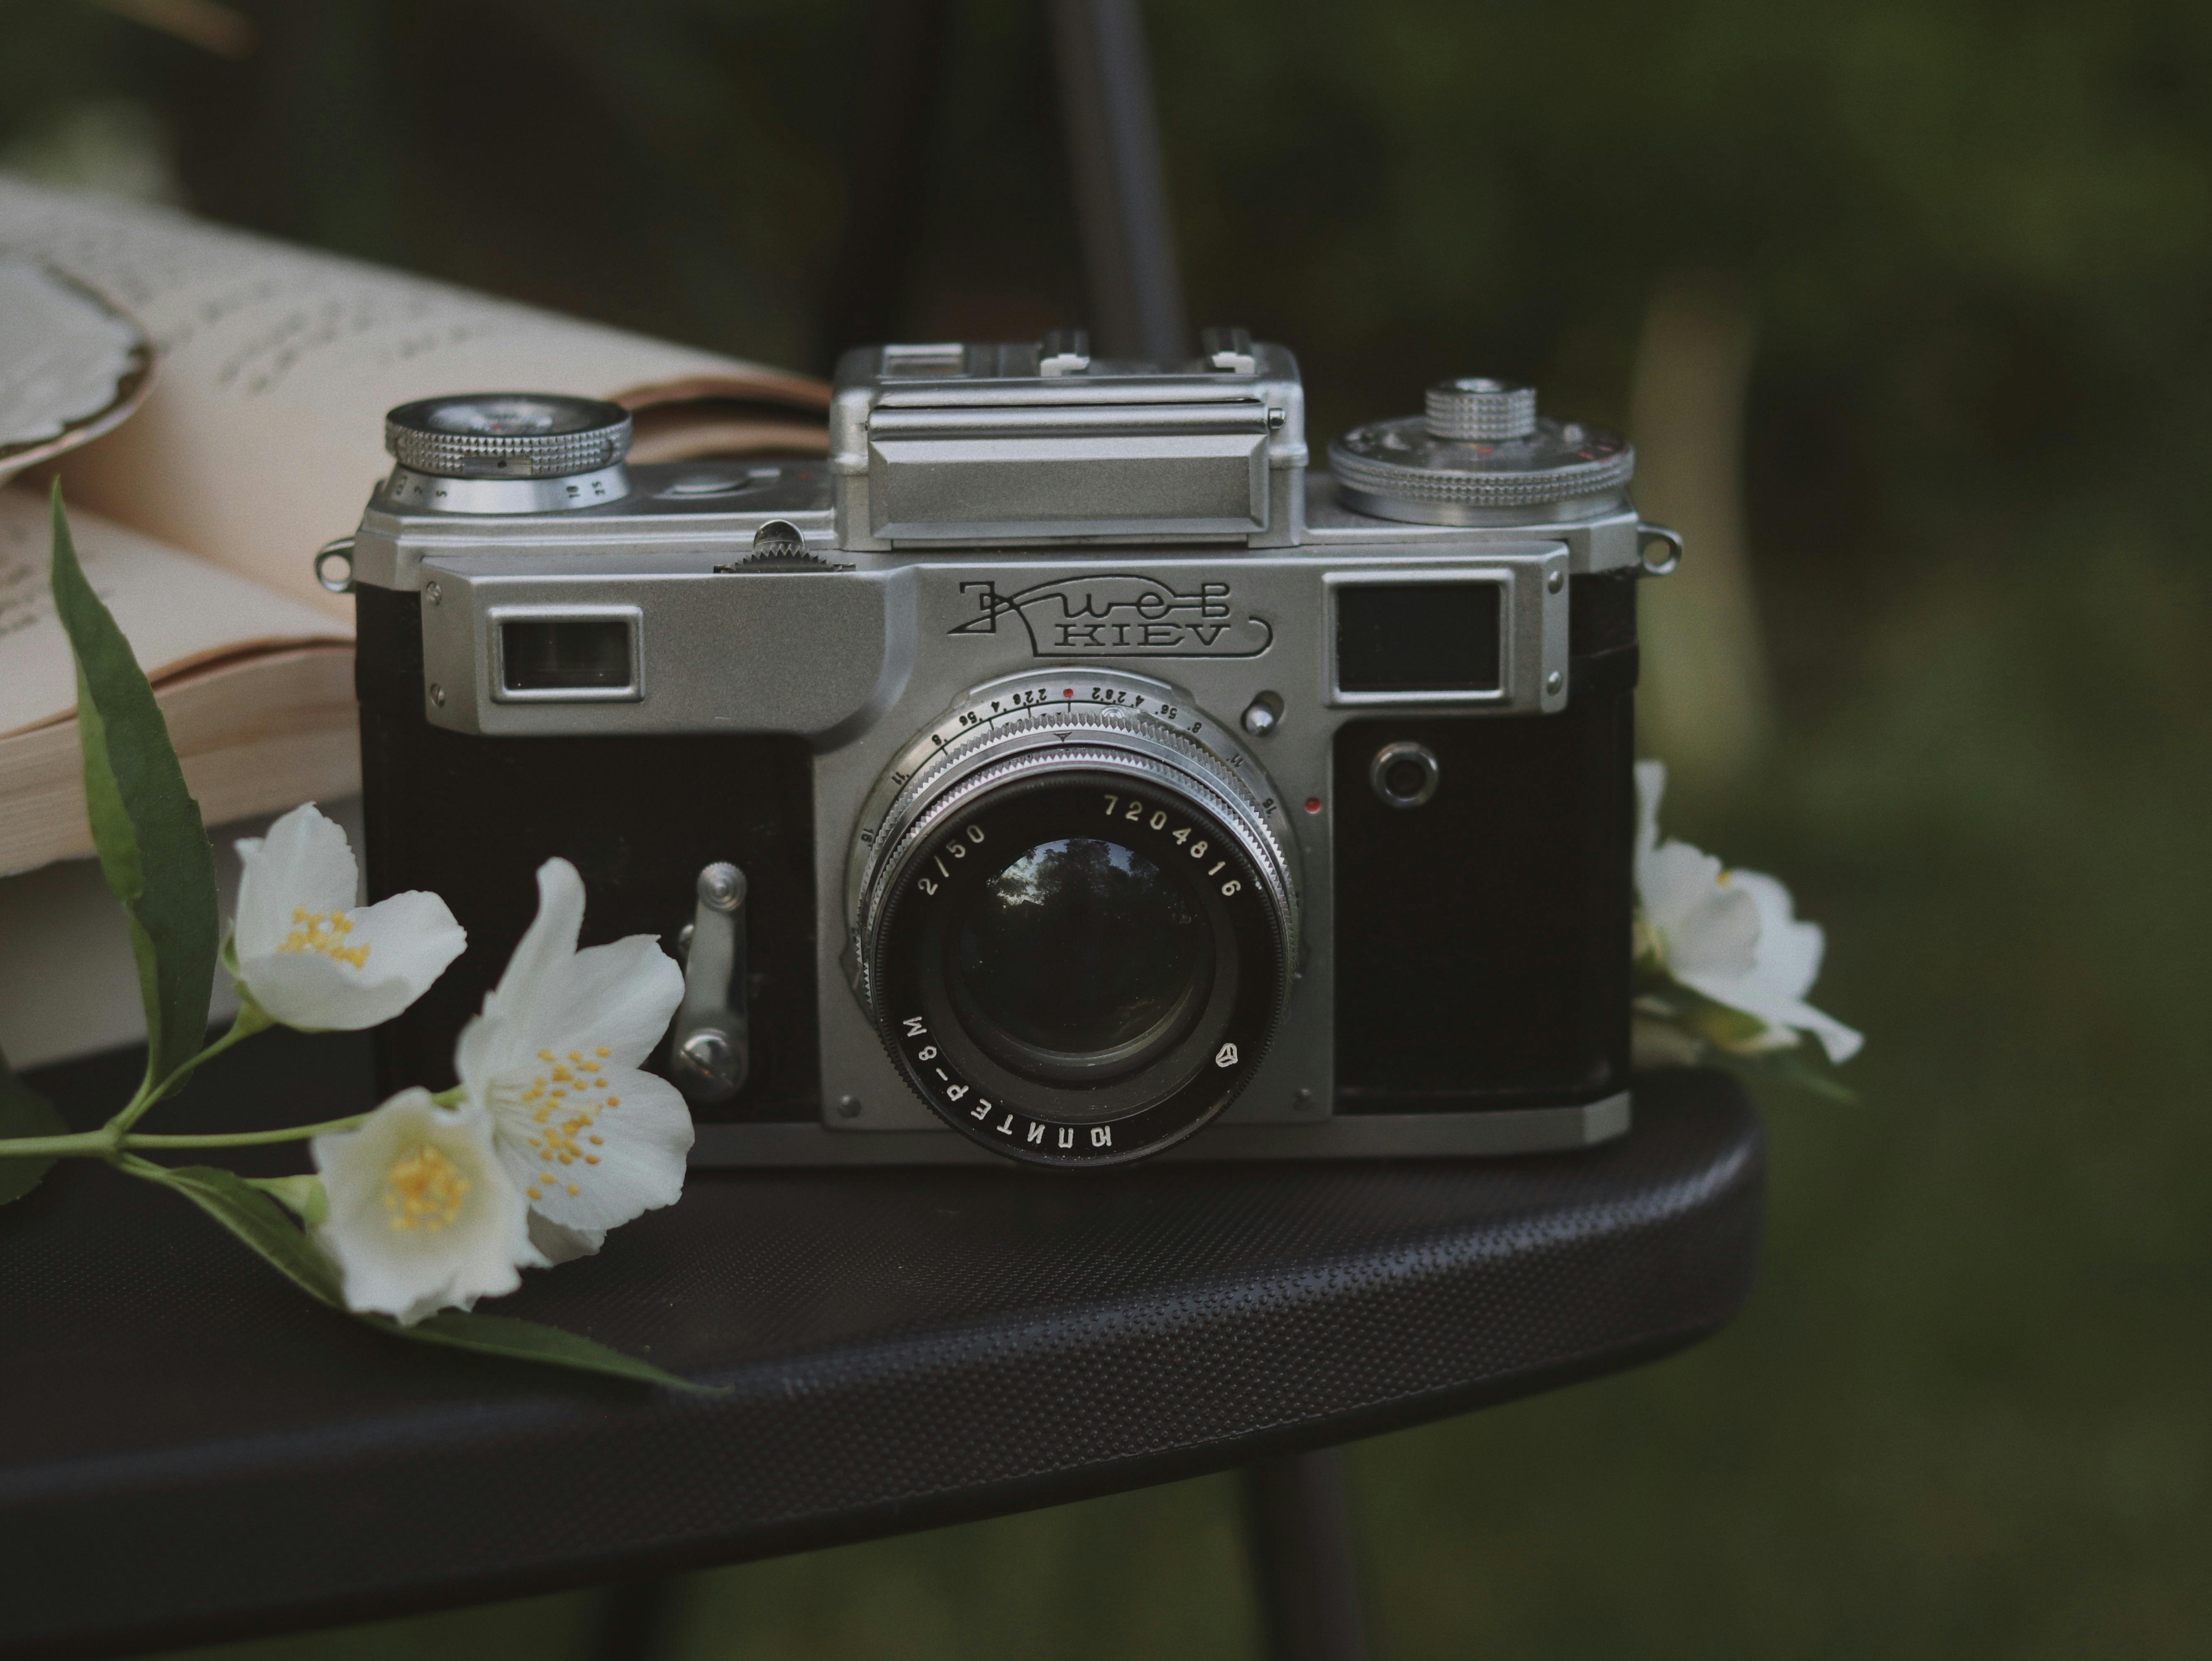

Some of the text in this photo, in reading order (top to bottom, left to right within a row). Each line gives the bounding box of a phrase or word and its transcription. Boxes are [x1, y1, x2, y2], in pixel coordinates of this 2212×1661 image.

[1054, 623, 1231, 647] KIEV
[1192, 722, 1202, 733] 8
[932, 734, 942, 746] 8
[1104, 794, 1241, 896] 7204816
[918, 825, 985, 895] 2/50
